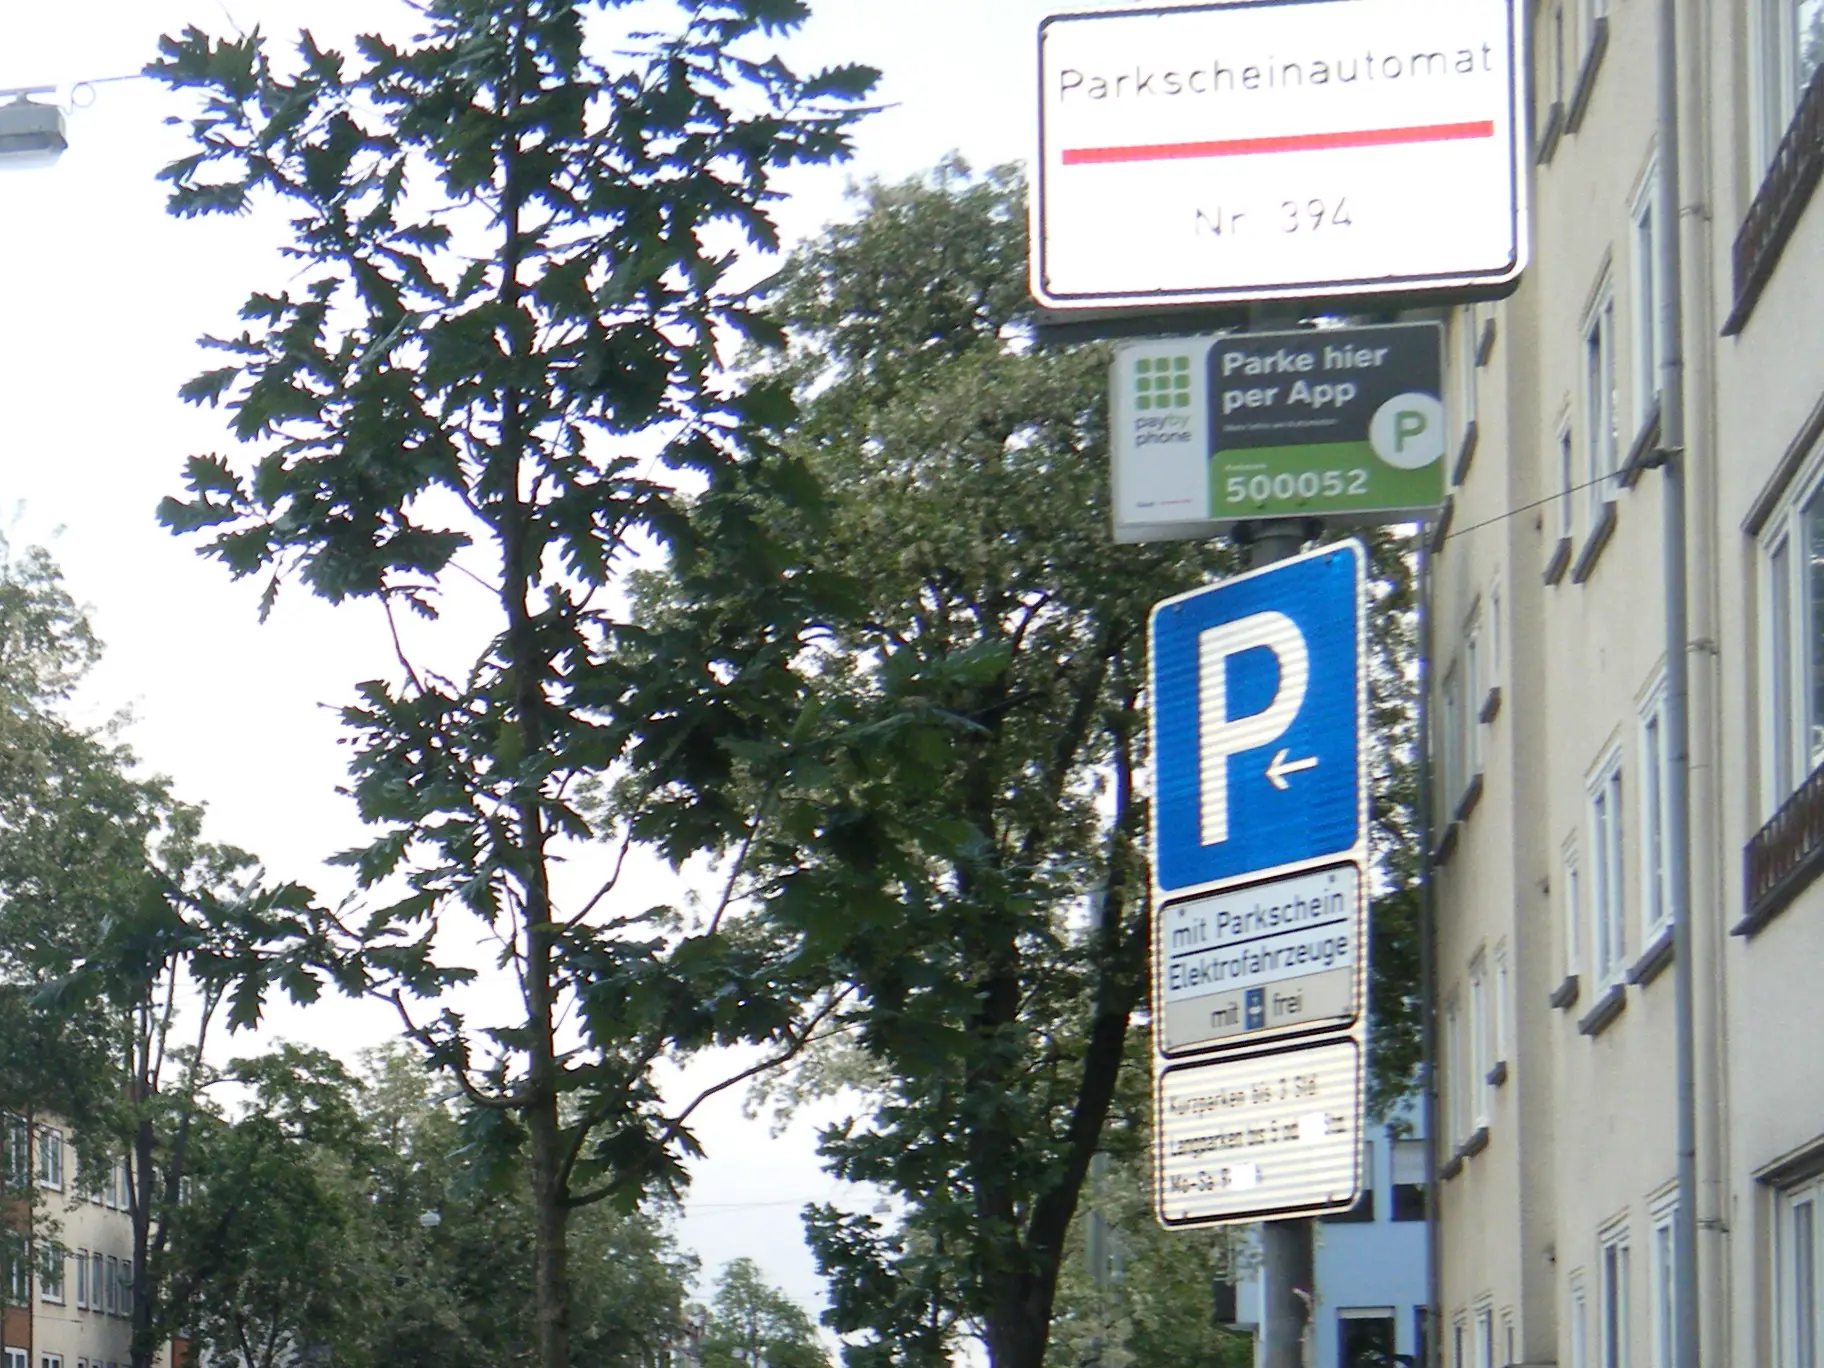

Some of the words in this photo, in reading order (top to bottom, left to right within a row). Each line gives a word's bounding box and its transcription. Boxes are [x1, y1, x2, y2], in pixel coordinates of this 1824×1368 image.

[1060, 42, 1493, 102] Parkscheinautomat
[1280, 196, 1353, 234] 394
[1222, 348, 1314, 377] Parke
[1323, 345, 1389, 371] hier
[1222, 386, 1279, 414] per
[1287, 379, 1356, 407] App
[1135, 431, 1192, 448] phone
[1393, 410, 1425, 452] P
[1225, 468, 1369, 503] 500052
[1199, 610, 1310, 847] P
[1172, 915, 1207, 948] mit
[1217, 889, 1345, 938] Parkschein
[1169, 934, 1348, 991] Elektrofahrzeuge
[1211, 1002, 1239, 1028] mit
[1272, 989, 1303, 1017] frei
[1170, 1129, 1243, 1159] Langparken
